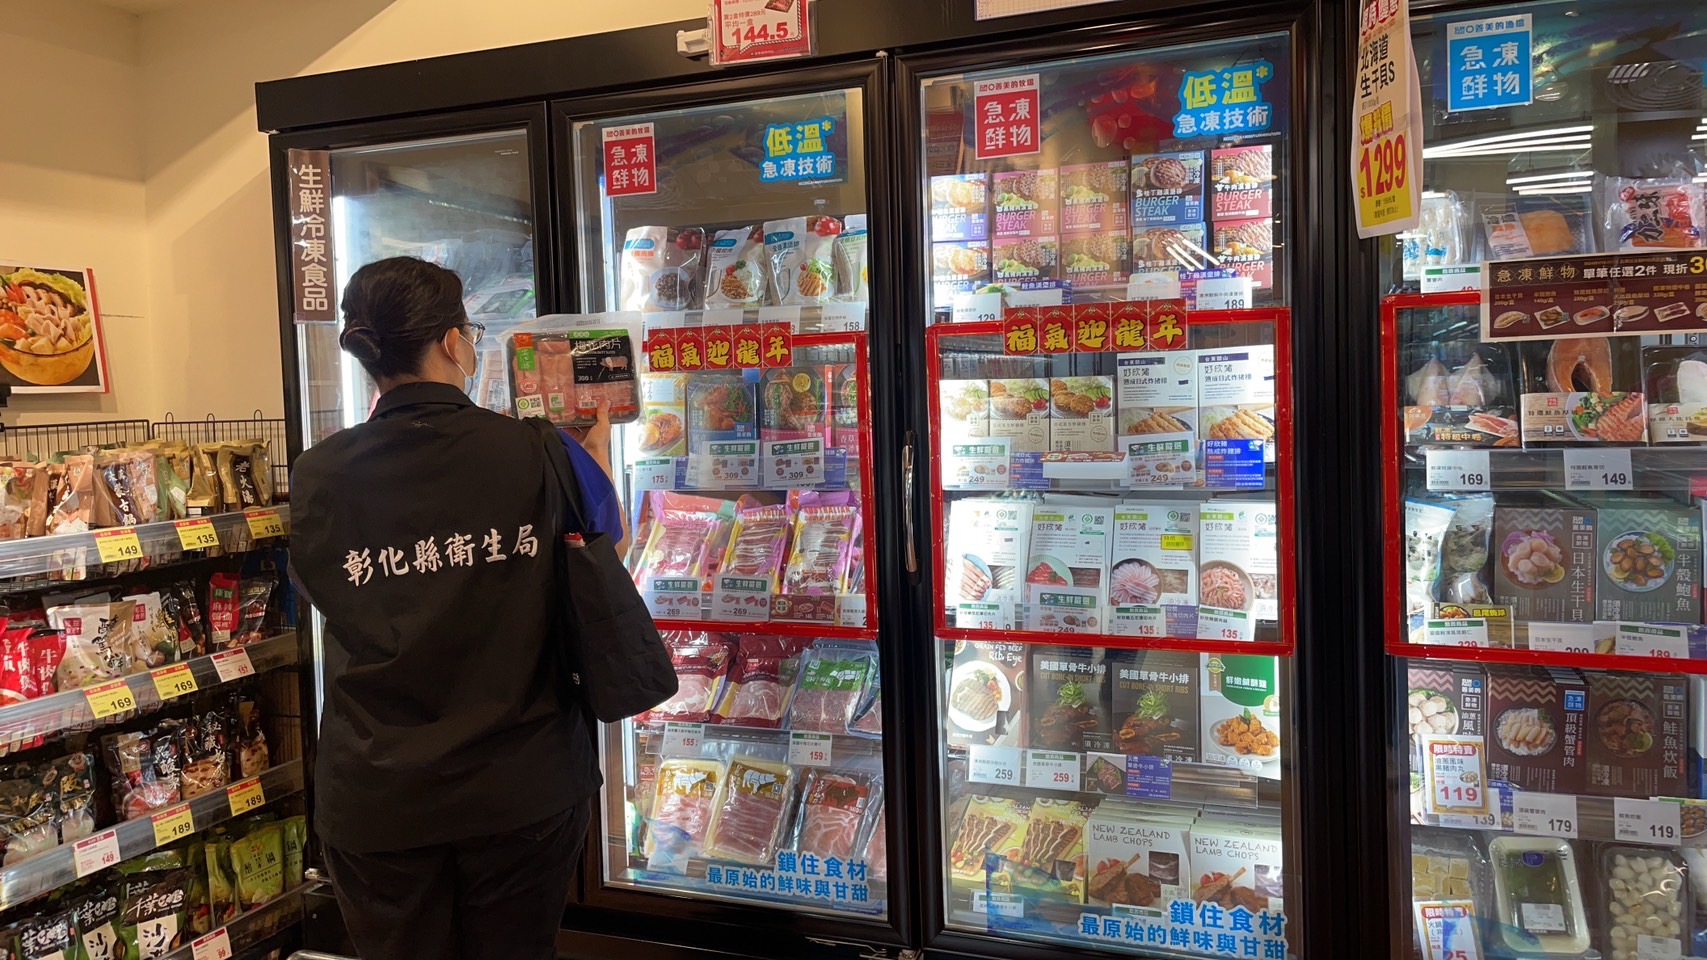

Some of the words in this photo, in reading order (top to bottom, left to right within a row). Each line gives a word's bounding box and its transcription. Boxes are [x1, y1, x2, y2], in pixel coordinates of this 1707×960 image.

[731, 22, 789, 44] 144.5
[1361, 34, 1389, 72] 北海道
[1460, 41, 1520, 71] 急凍
[1361, 61, 1395, 98] 生干貝S
[1460, 71, 1520, 100] 鮮物
[1183, 72, 1257, 109] 低溫
[984, 98, 1031, 124] 急凍
[1176, 106, 1268, 134] 急凍技術
[766, 124, 824, 157] 低溫
[984, 124, 1031, 150] 鮮物
[610, 143, 648, 167] 急凍
[762, 155, 833, 179] 急凍技術
[612, 167, 649, 190] 鮮物
[1135, 196, 1179, 207] BURGER
[1216, 189, 1262, 201] BURGER
[1065, 203, 1107, 214] BURGER
[1135, 207, 1169, 217] STEAK
[1216, 200, 1252, 212] STEAK
[996, 210, 1036, 222] BURGER
[1065, 214, 1097, 224] STEAK
[996, 220, 1027, 231] STEAK
[298, 165, 328, 311] 生鮮冷凍食品
[1067, 272, 1107, 283] BURGER
[1497, 265, 1575, 282] 急凍鮮物
[1583, 265, 1656, 279] 單筆任選2件
[1663, 263, 1688, 275] 現折
[1224, 299, 1245, 310] 189
[978, 313, 996, 321] 129
[843, 322, 860, 331] 158
[1007, 314, 1184, 351] 福氣迎龍年
[650, 336, 790, 369] 福氣迎龍年
[652, 475, 664, 483] 175
[789, 471, 804, 479] 309
[969, 475, 985, 483] 249
[1151, 474, 1169, 482] 249
[1460, 473, 1484, 486] 169
[1601, 472, 1627, 486] 149
[235, 461, 254, 504] 老火湯
[264, 524, 281, 534] 135
[197, 534, 215, 544] 135
[118, 545, 138, 556] 149
[342, 524, 539, 587] 彰化縣衛生局
[1570, 552, 1585, 622] 日本生干貝
[1675, 553, 1691, 611] 半殼鮑魚
[979, 621, 993, 629] 135
[1138, 625, 1154, 634] 135
[1221, 629, 1238, 638] 135
[1649, 649, 1671, 658] 189
[1040, 660, 1107, 674] 美國單骨牛小排
[1119, 669, 1189, 684] 美國單骨牛小排
[174, 680, 193, 692] 169
[1155, 684, 1174, 692] SHORT
[1175, 685, 1189, 694] RIBS
[110, 697, 132, 710] 169
[682, 738, 695, 747] 155
[1563, 712, 1578, 767] 頂級蟹管肉
[809, 751, 824, 760] 159
[1433, 744, 1473, 754] 限時特賣
[1663, 721, 1678, 779] 鮭魚炊飯
[995, 768, 1013, 780] 259
[1053, 772, 1070, 782] 259
[245, 794, 262, 807] 189
[1440, 786, 1477, 801] 119
[1472, 813, 1495, 826] 139
[1548, 819, 1572, 832] 179
[172, 822, 190, 836] 189
[1092, 823, 1117, 834] NEW
[1119, 826, 1171, 840] ZEALAND
[1649, 824, 1674, 839] 119
[1092, 833, 1118, 844] LAMB
[1122, 835, 1153, 847] CHOPS
[1194, 838, 1219, 848] NEW
[1222, 839, 1278, 852] ZEALAND
[101, 853, 115, 864] 149
[1195, 846, 1222, 858] LAMB
[1226, 848, 1260, 860] CHOPS
[778, 851, 868, 881] 鎖住食材
[707, 868, 869, 902] 最原始的鮮味與甘甜
[1170, 901, 1286, 936] 鎖住食材
[1081, 917, 1286, 959] 最原始的鮮味與甘甜
